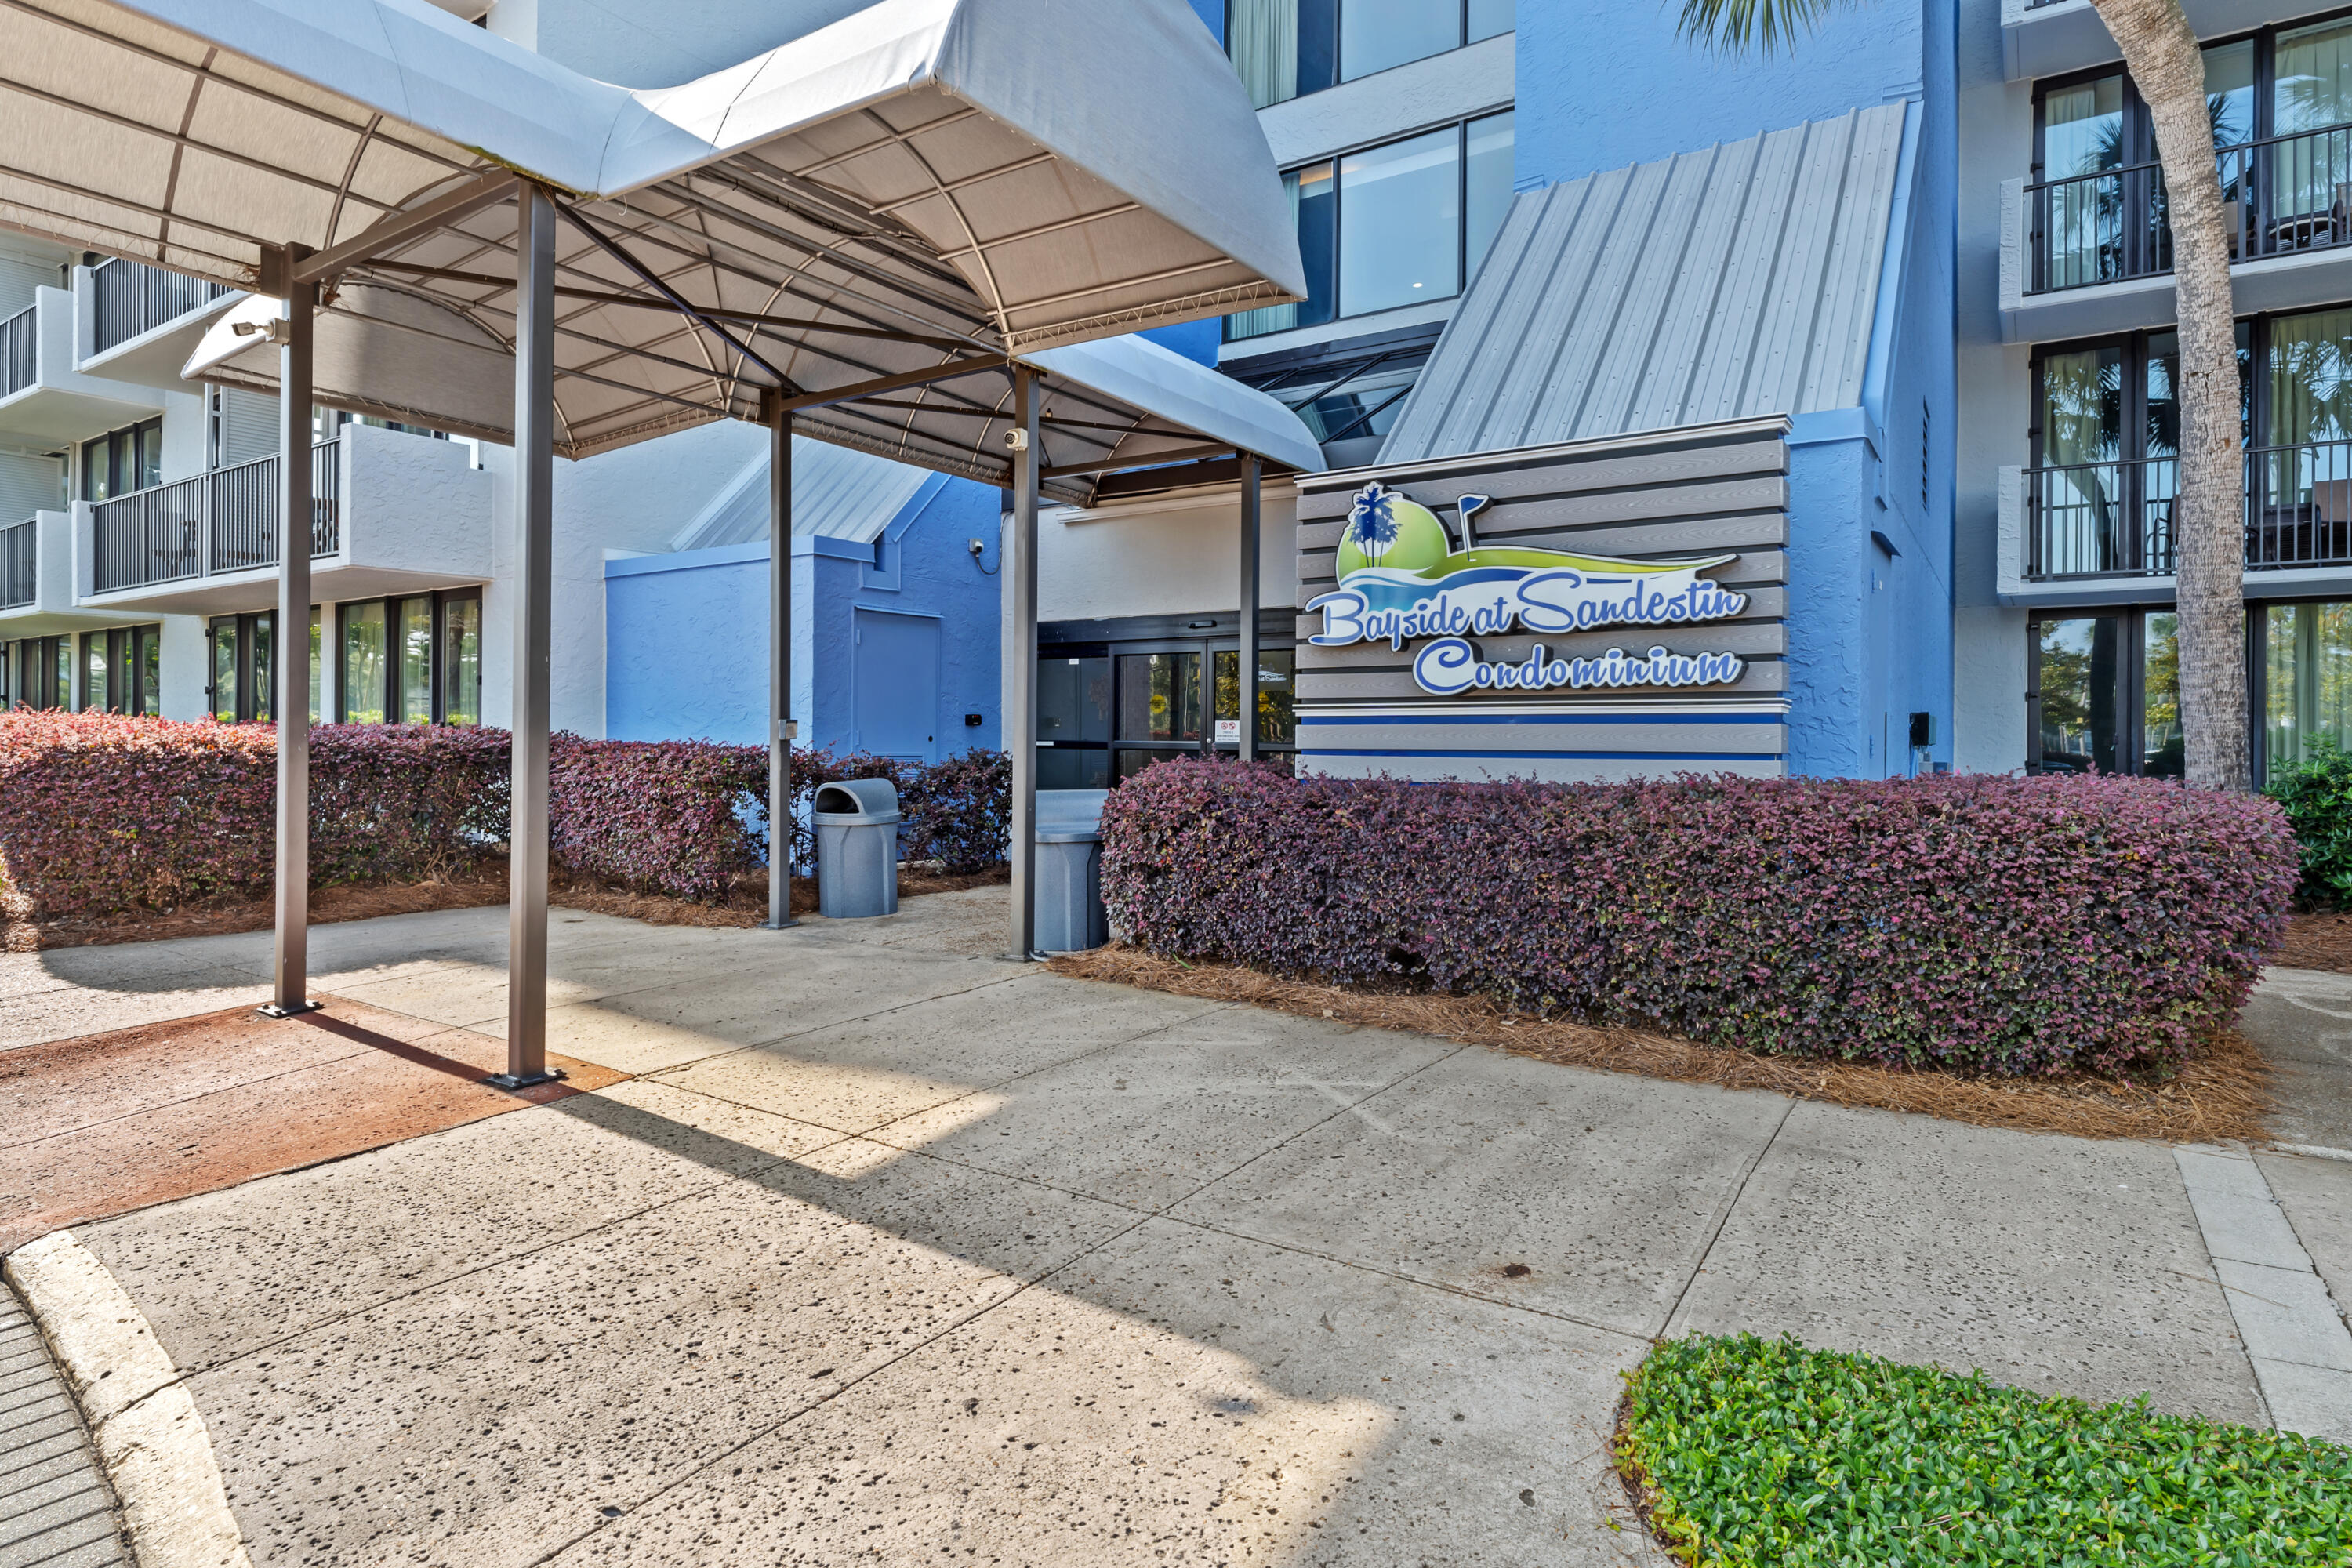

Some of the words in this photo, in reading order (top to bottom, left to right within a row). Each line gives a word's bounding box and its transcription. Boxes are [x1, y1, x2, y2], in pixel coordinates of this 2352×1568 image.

[1307, 593, 1470, 649] Bayside
[1474, 596, 1512, 633] at
[1516, 571, 1743, 631] Sandestin
[1415, 639, 1739, 693] Condominium
